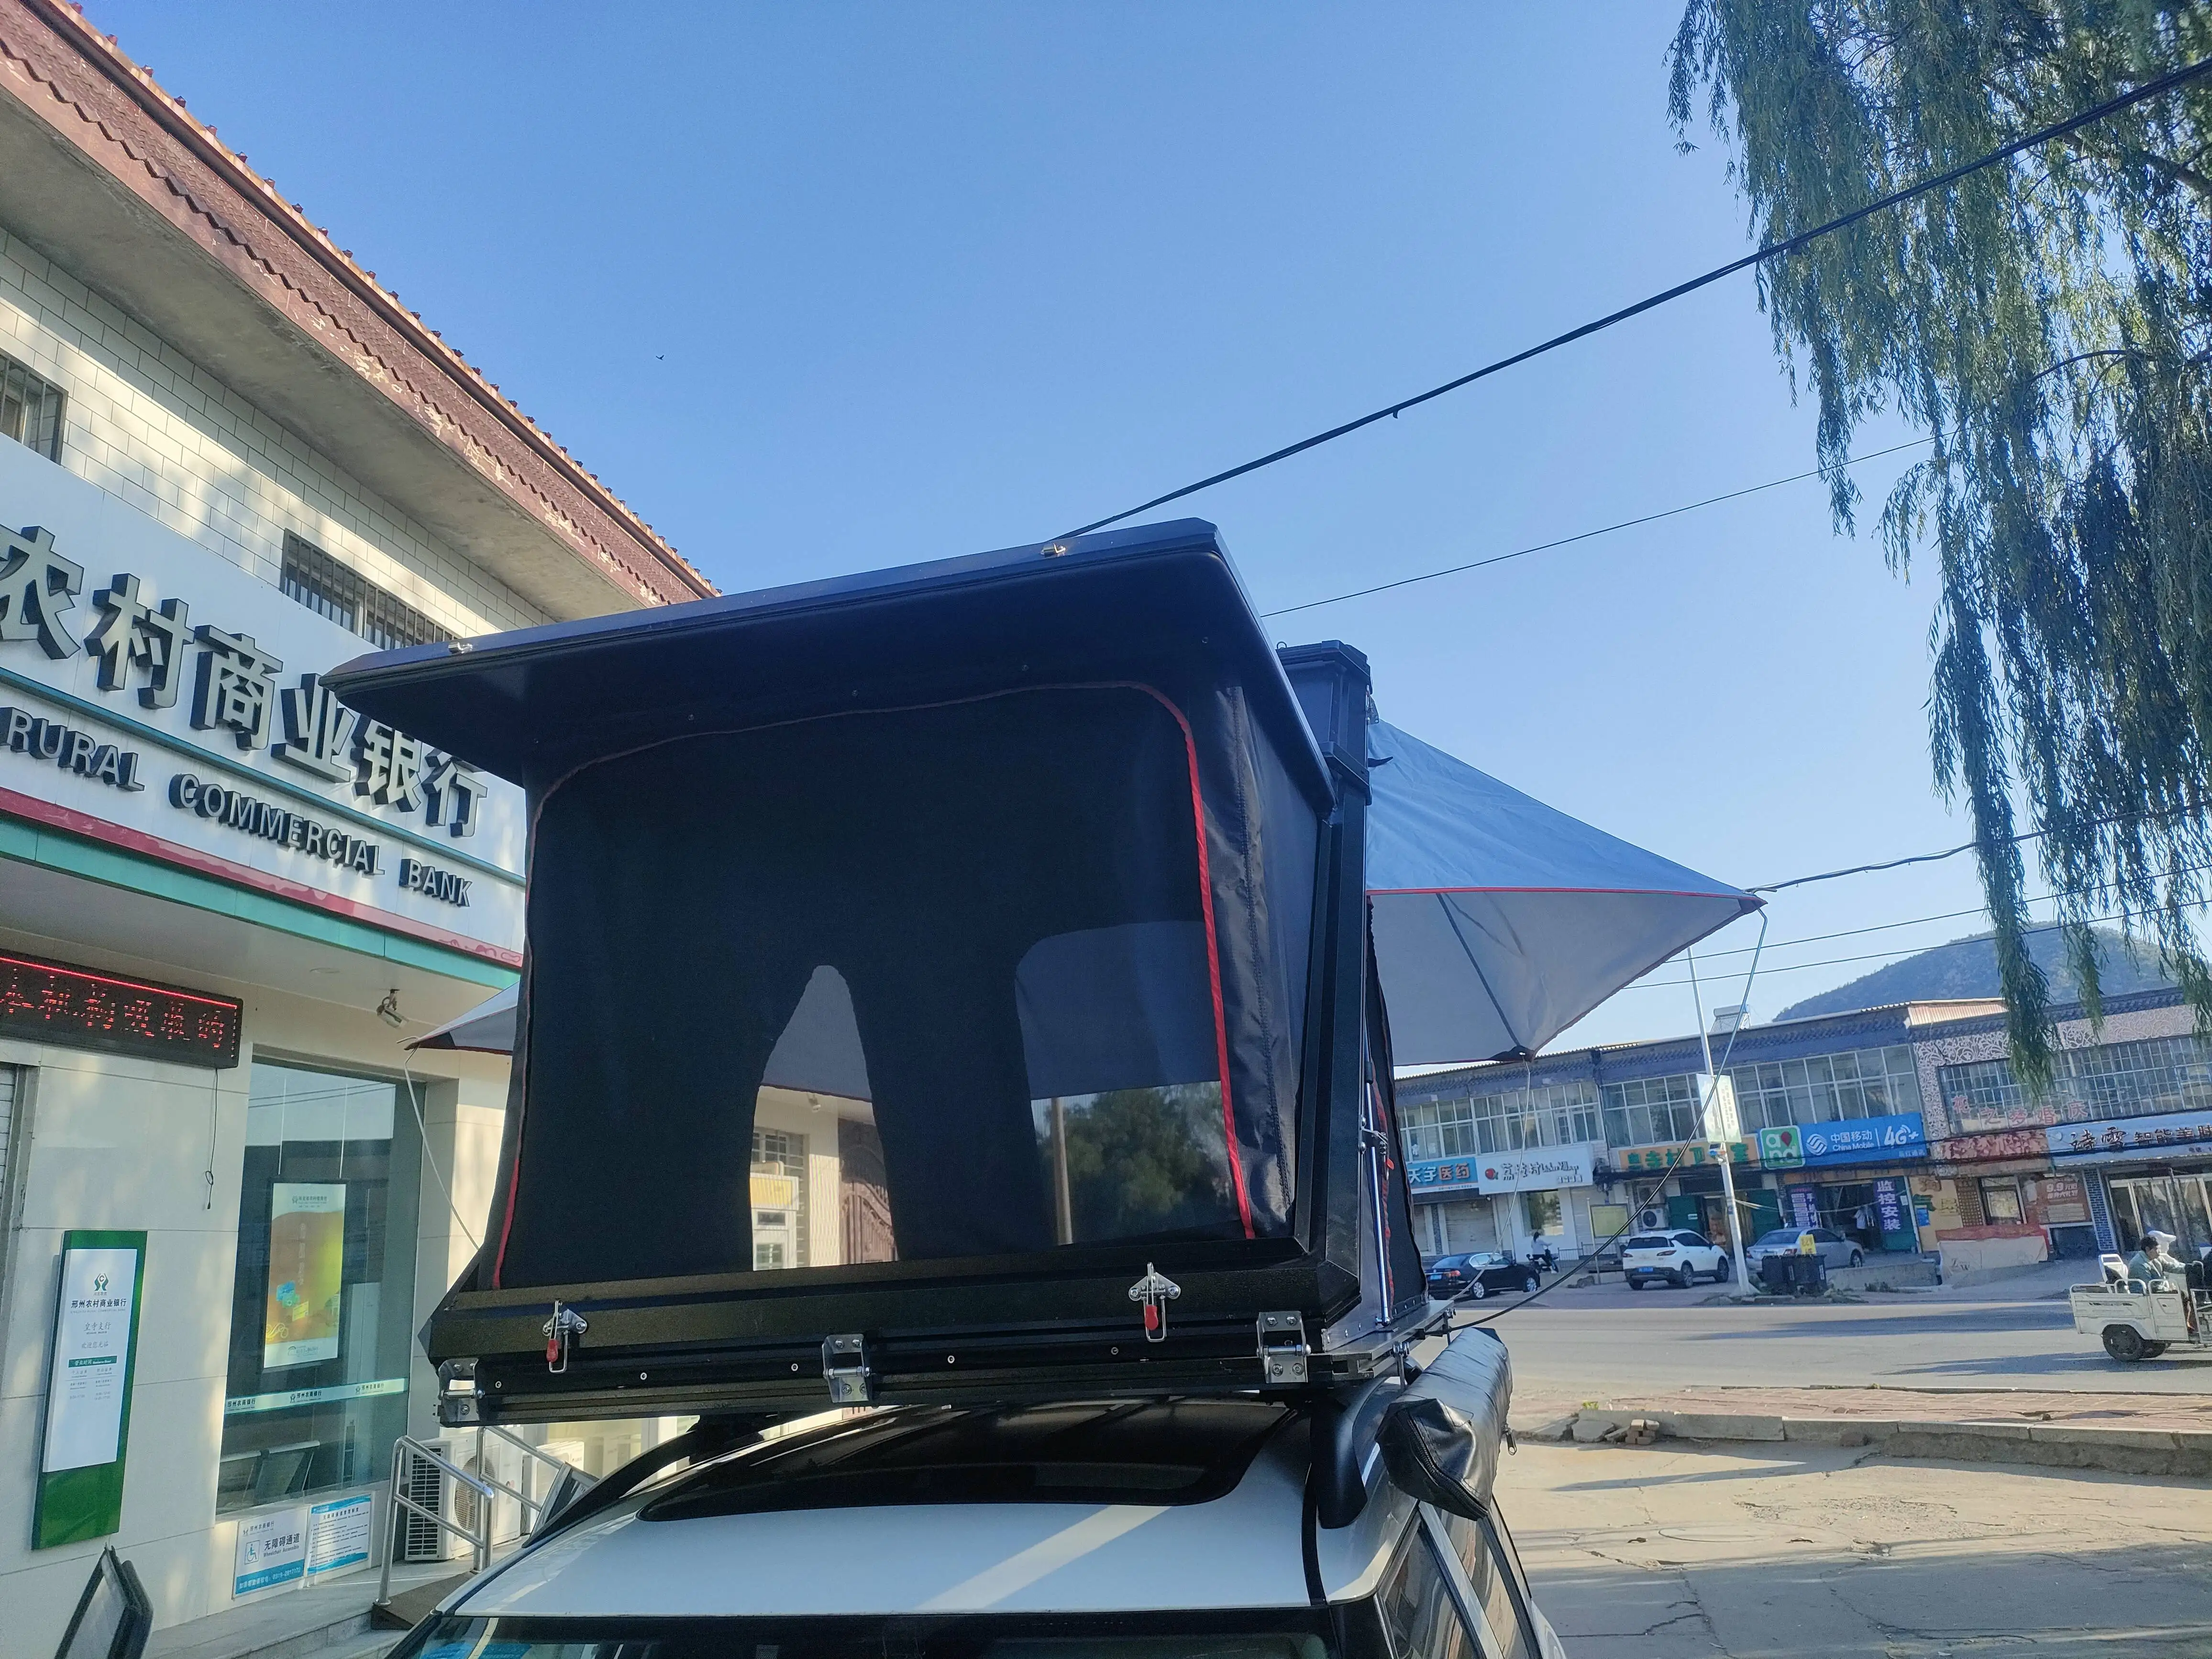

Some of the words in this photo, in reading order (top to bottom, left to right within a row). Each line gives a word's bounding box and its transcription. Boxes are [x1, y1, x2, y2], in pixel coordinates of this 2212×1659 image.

[0, 525, 487, 837] 农村商业银行
[1, 707, 145, 791] RURAL
[169, 774, 386, 875] COMMERCIAL
[399, 858, 473, 907] BANK
[1830, 1130, 1873, 1143] 中国移动
[1877, 1180, 1901, 1231] 监控安装
[71, 1298, 127, 1309] 邢州农村商业银行
[264, 1533, 300, 1551] 无障碍通道
